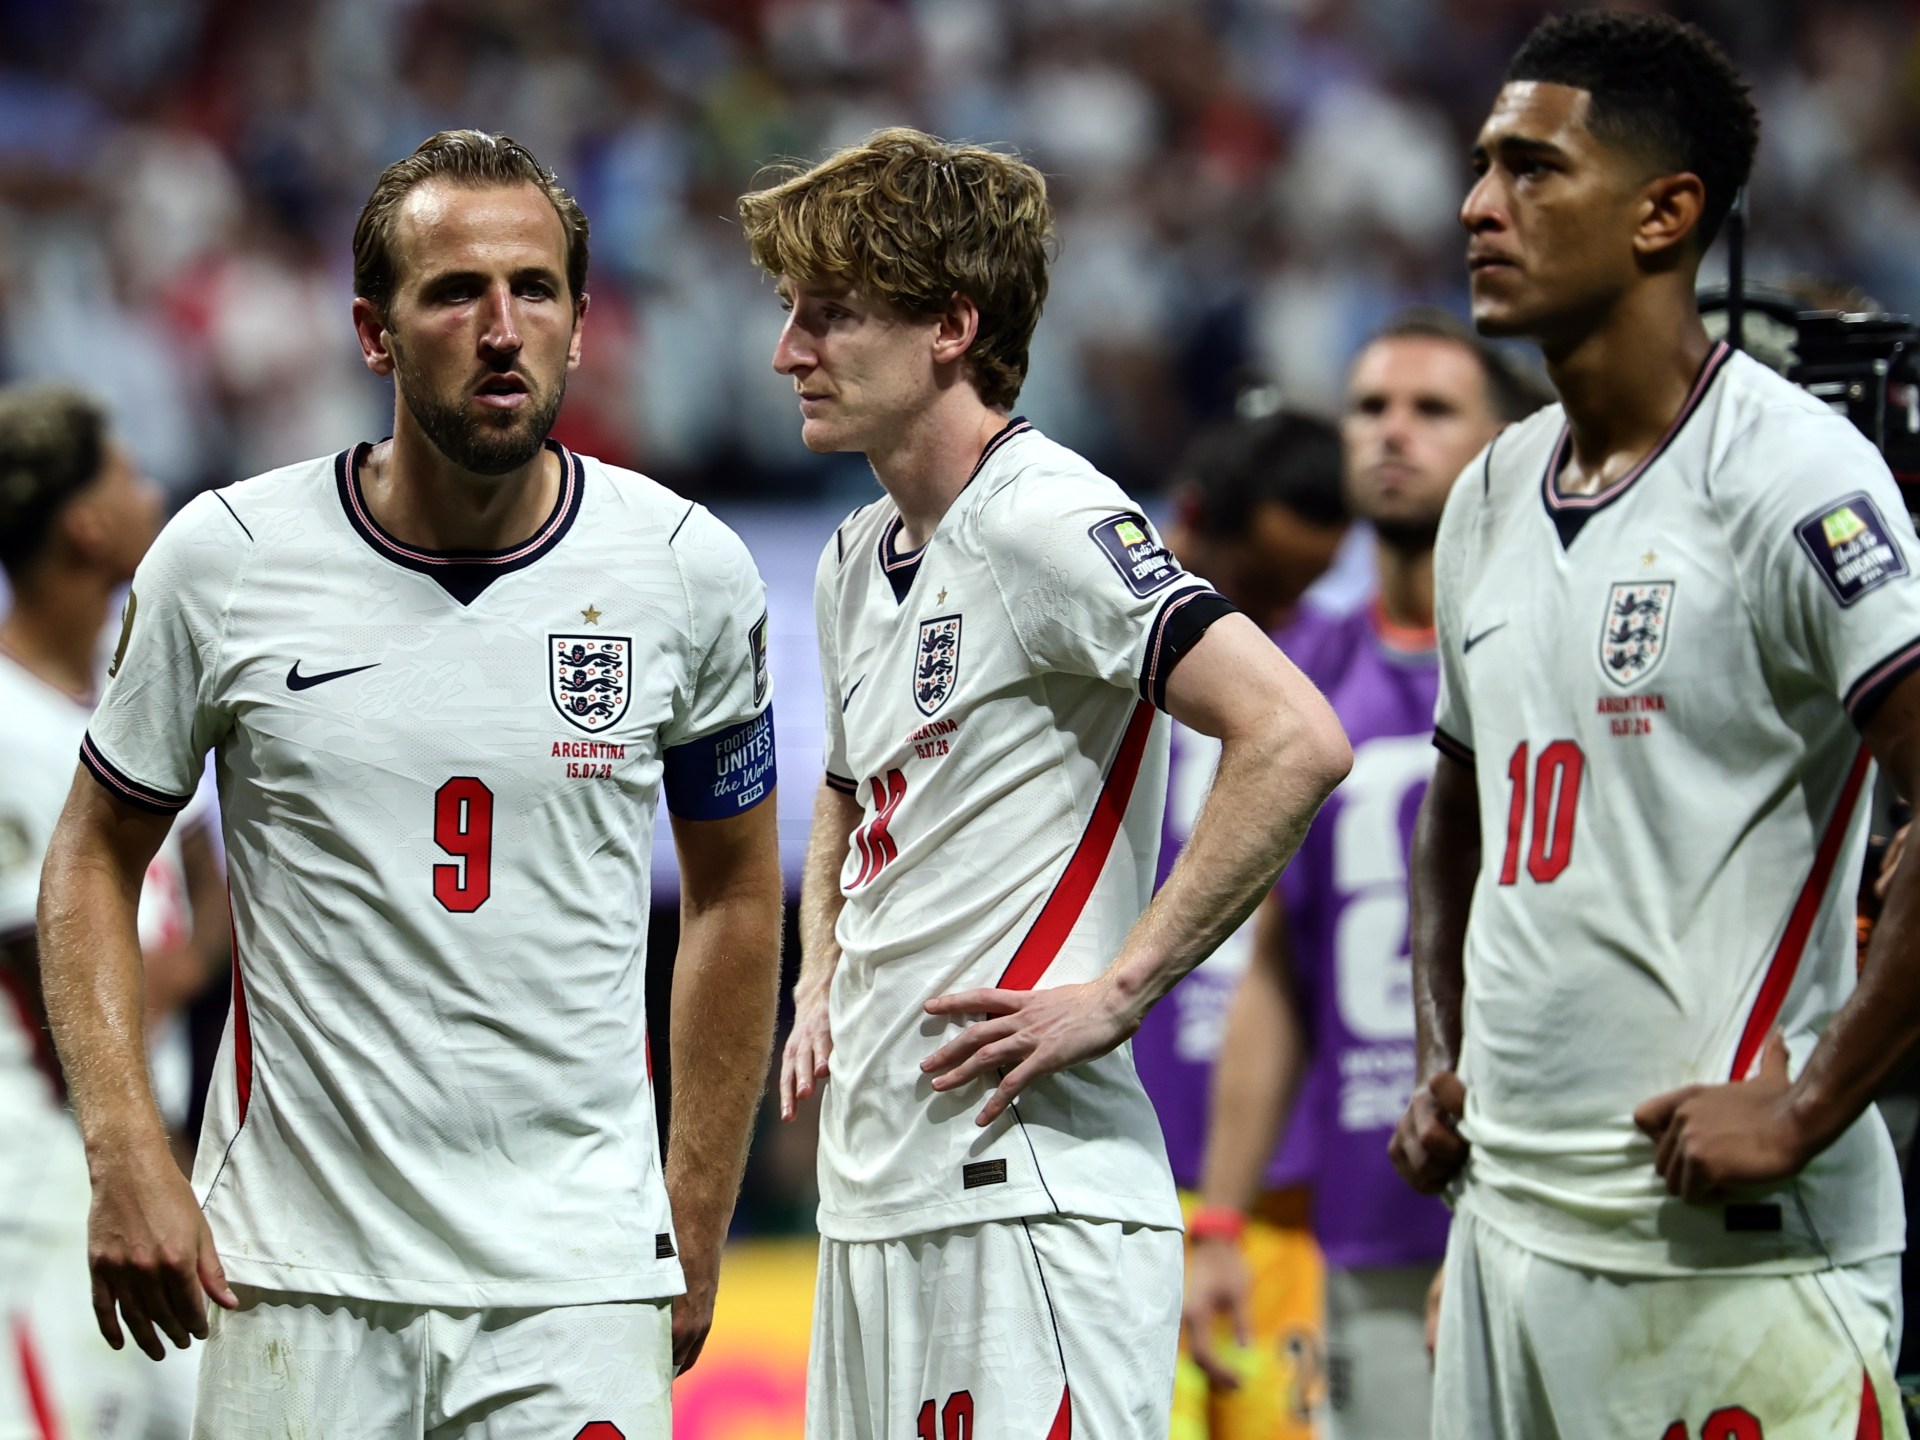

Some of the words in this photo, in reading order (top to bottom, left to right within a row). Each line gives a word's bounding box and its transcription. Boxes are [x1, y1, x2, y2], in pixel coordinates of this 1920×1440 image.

[1597, 694, 1665, 714] ARGENTINA
[715, 712, 769, 756] FOOTBALL
[914, 739, 949, 759] 15.07.26
[551, 741, 625, 760] ARGENTINA
[716, 727, 770, 776] UNITES
[566, 762, 613, 780] 15.07.26
[711, 777, 741, 797] the
[743, 746, 774, 787] World
[739, 785, 762, 804] FIFA
[1499, 738, 1585, 885] 10
[433, 776, 494, 913] 9
